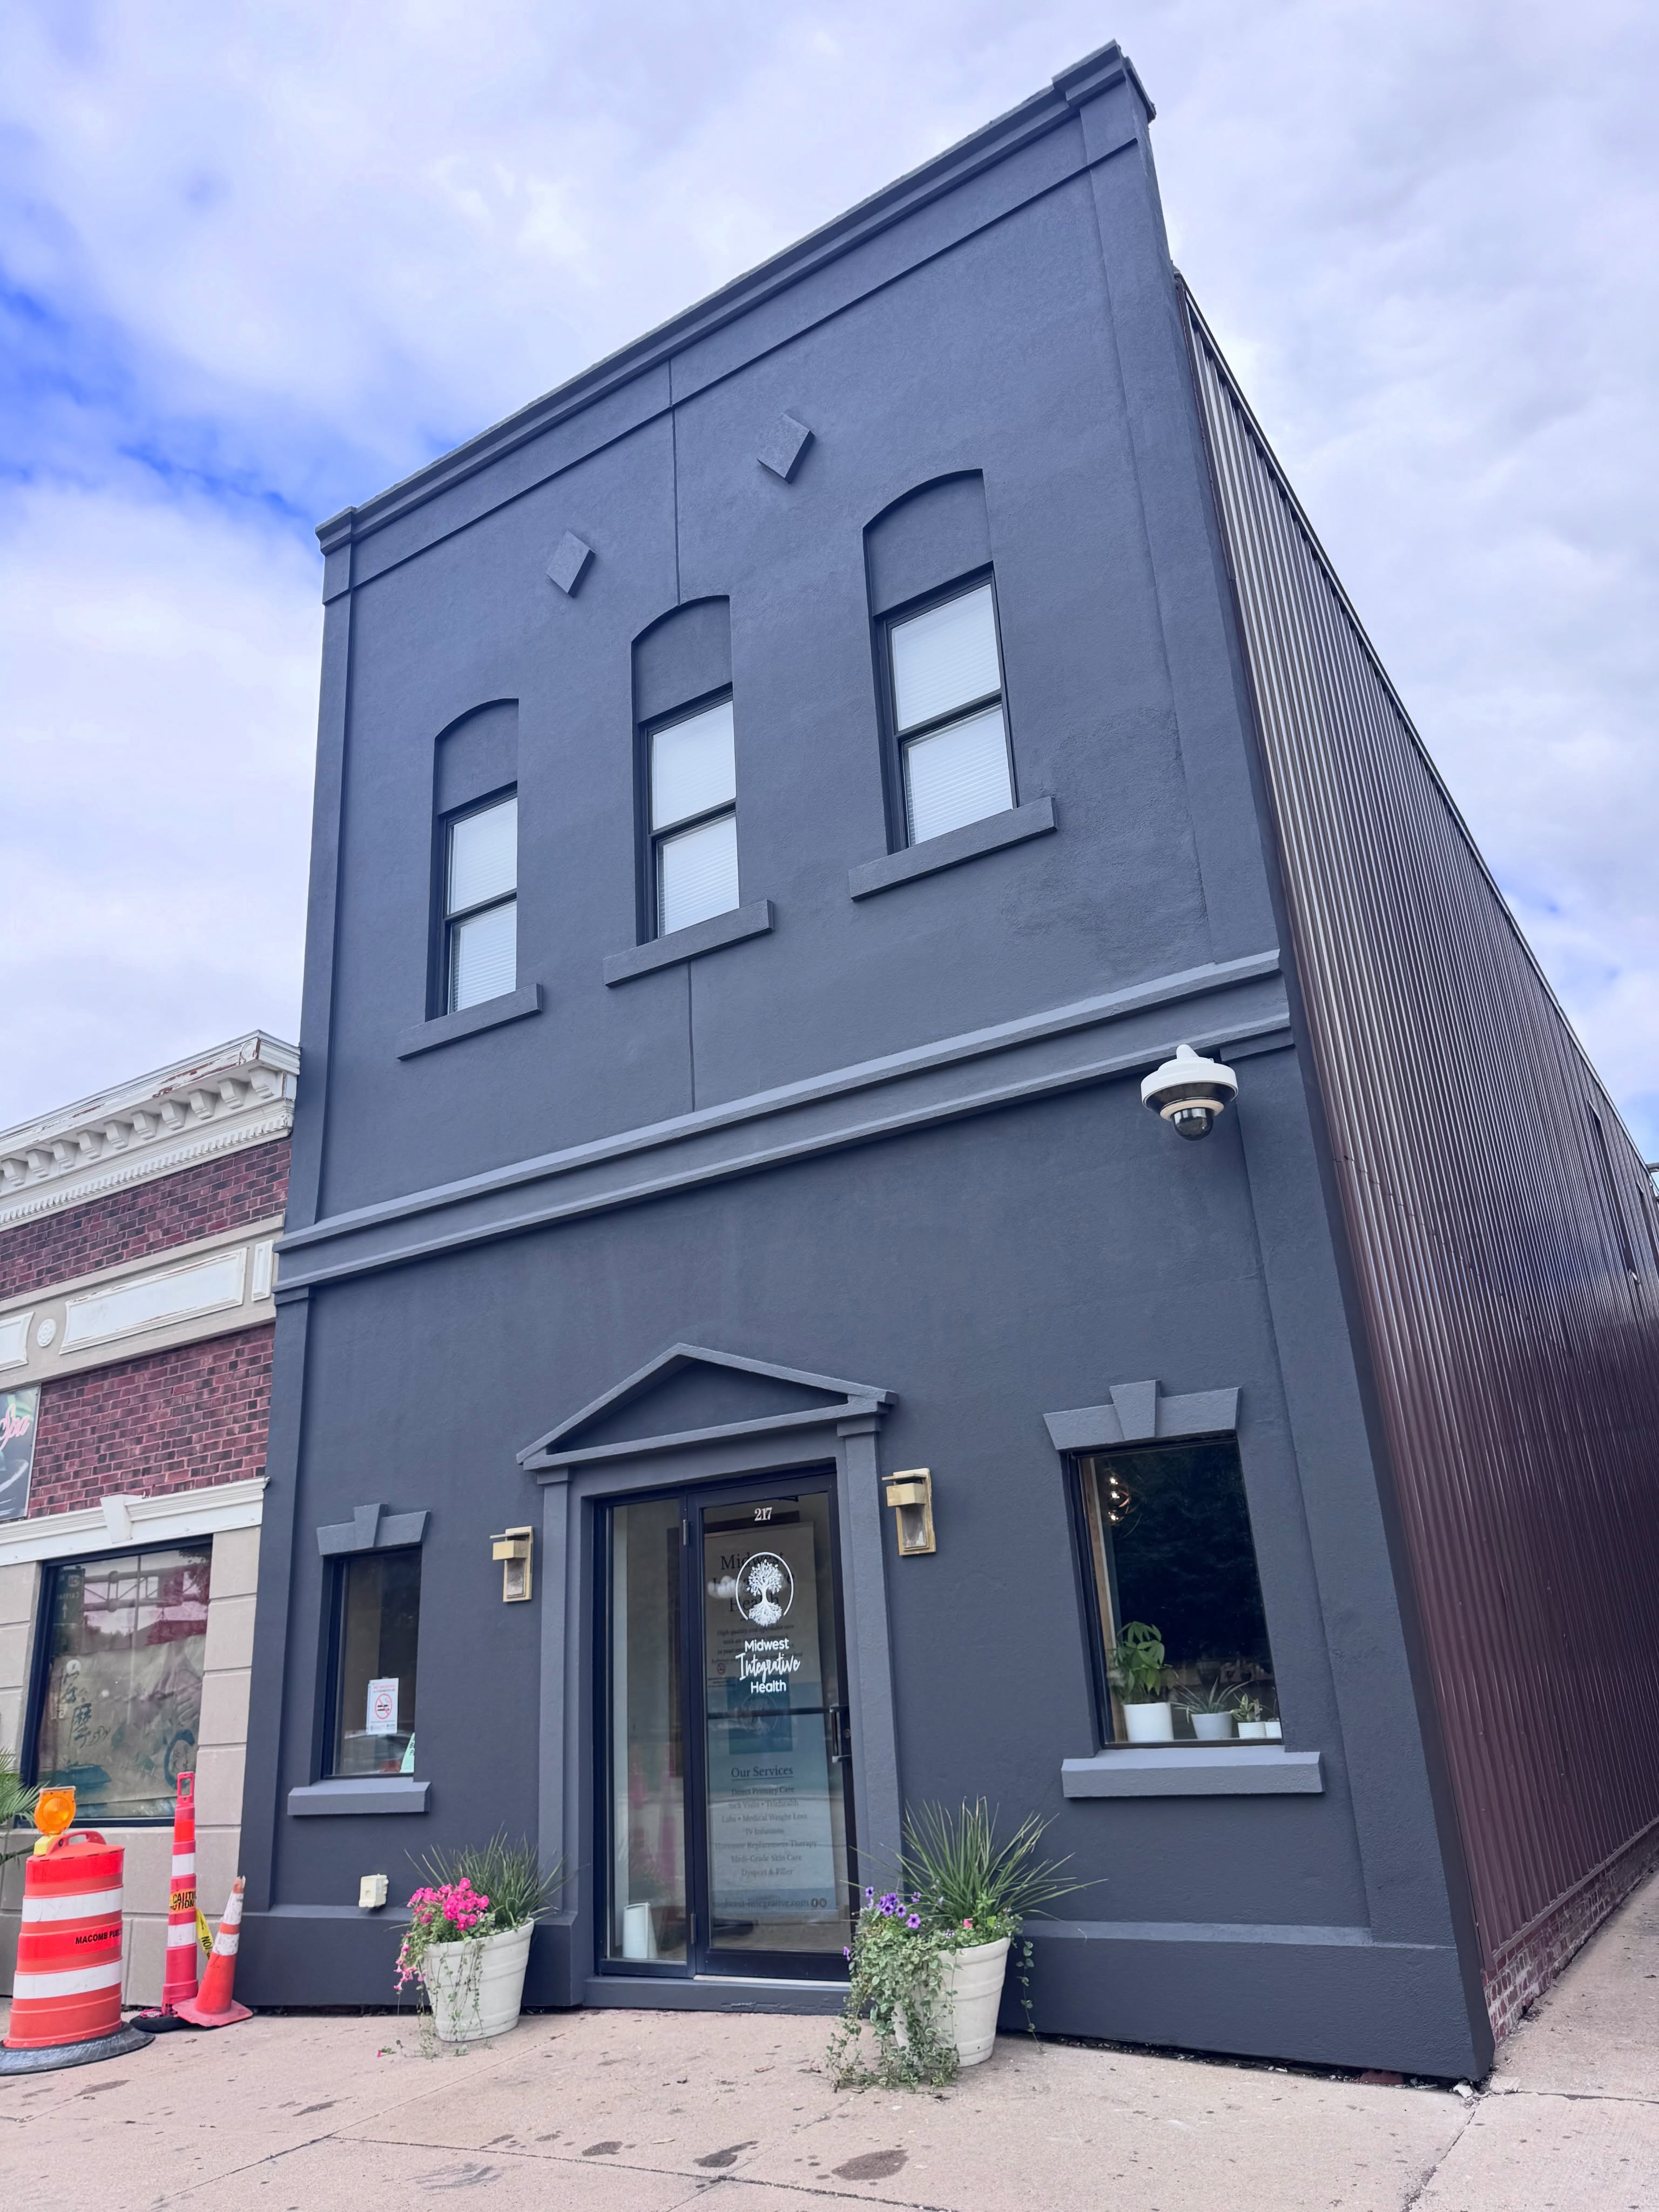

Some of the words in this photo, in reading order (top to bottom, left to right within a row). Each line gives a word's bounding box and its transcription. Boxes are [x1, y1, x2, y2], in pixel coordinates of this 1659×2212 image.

[754, 1507, 772, 1521] 217
[730, 1591, 779, 1612] Healh
[745, 1637, 790, 1653] Midwest
[735, 1652, 800, 1683] Integrative
[751, 1679, 787, 1694] Health
[731, 1767, 751, 1778] Our
[753, 1765, 793, 1777] Services
[75, 1932, 108, 1945] MACOMB
